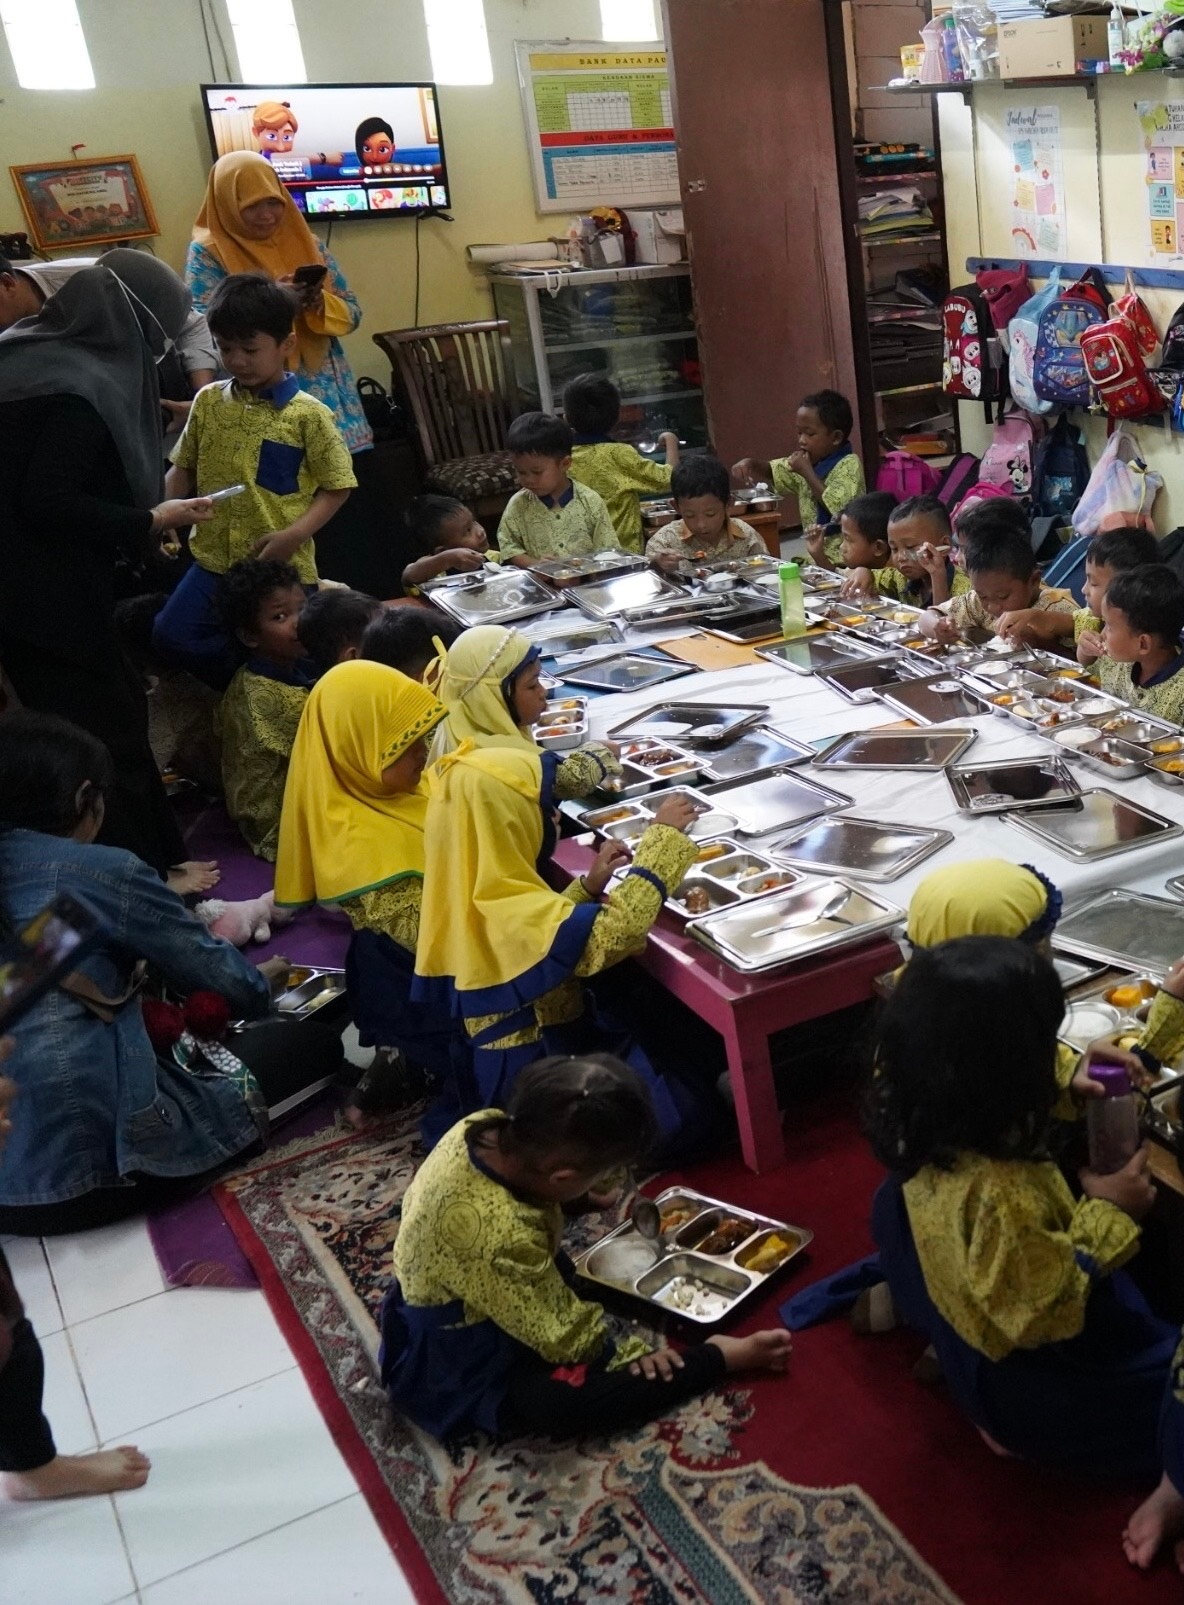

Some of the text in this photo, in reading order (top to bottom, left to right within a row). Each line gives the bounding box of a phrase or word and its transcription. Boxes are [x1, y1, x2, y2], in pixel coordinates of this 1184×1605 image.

[615, 57, 643, 65] DATA
[647, 56, 667, 64] PAU
[945, 303, 966, 314] LABUBU
